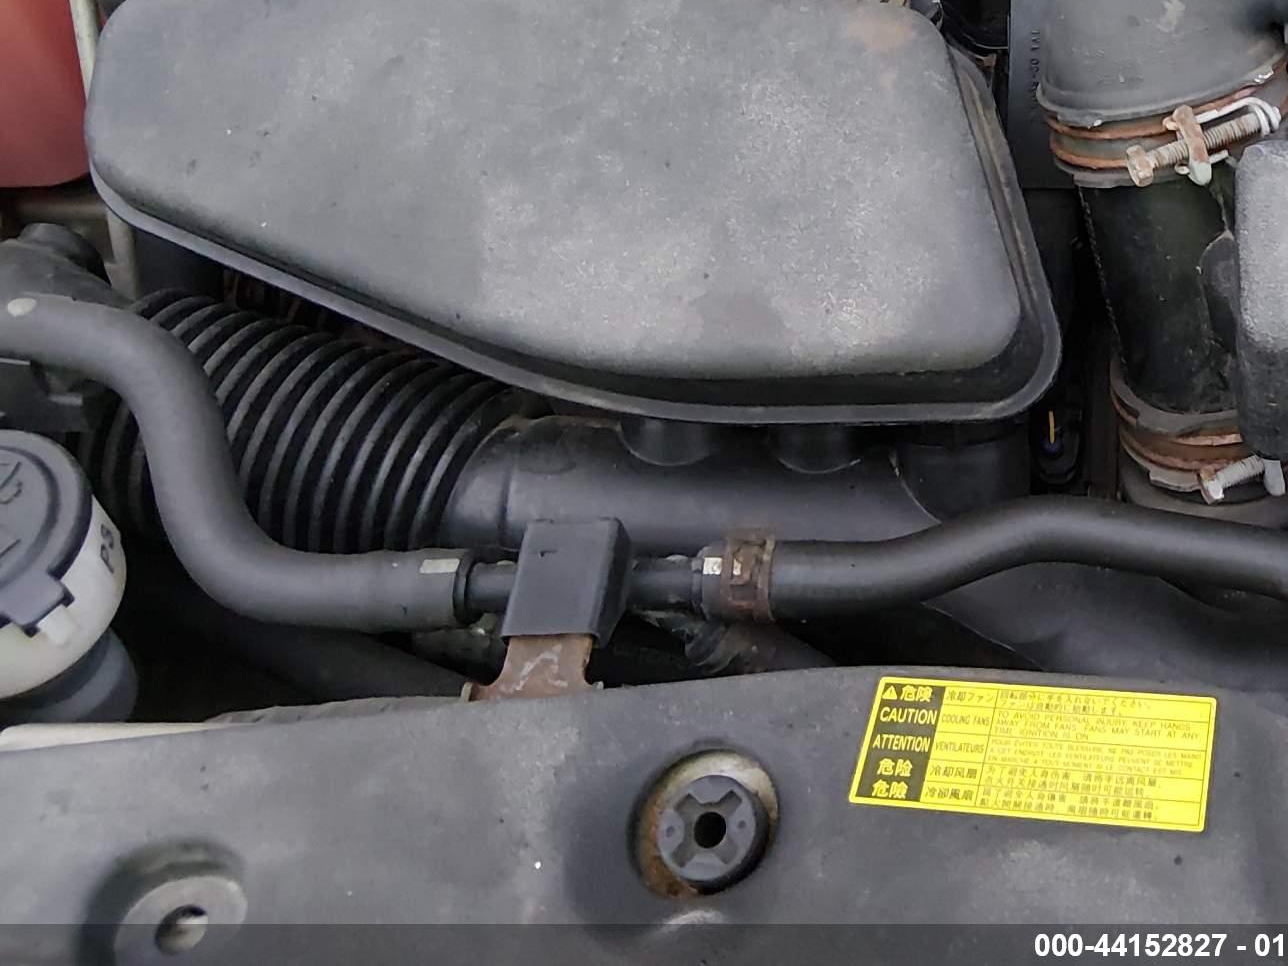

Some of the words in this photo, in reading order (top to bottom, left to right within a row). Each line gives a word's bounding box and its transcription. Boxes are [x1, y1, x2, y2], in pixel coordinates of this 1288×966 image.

[879, 706, 938, 726] CAUTION
[940, 712, 971, 725] COOLING
[971, 715, 991, 726] FANS
[872, 733, 932, 753] ATTENTION
[933, 740, 985, 754] VENTILATEURS
